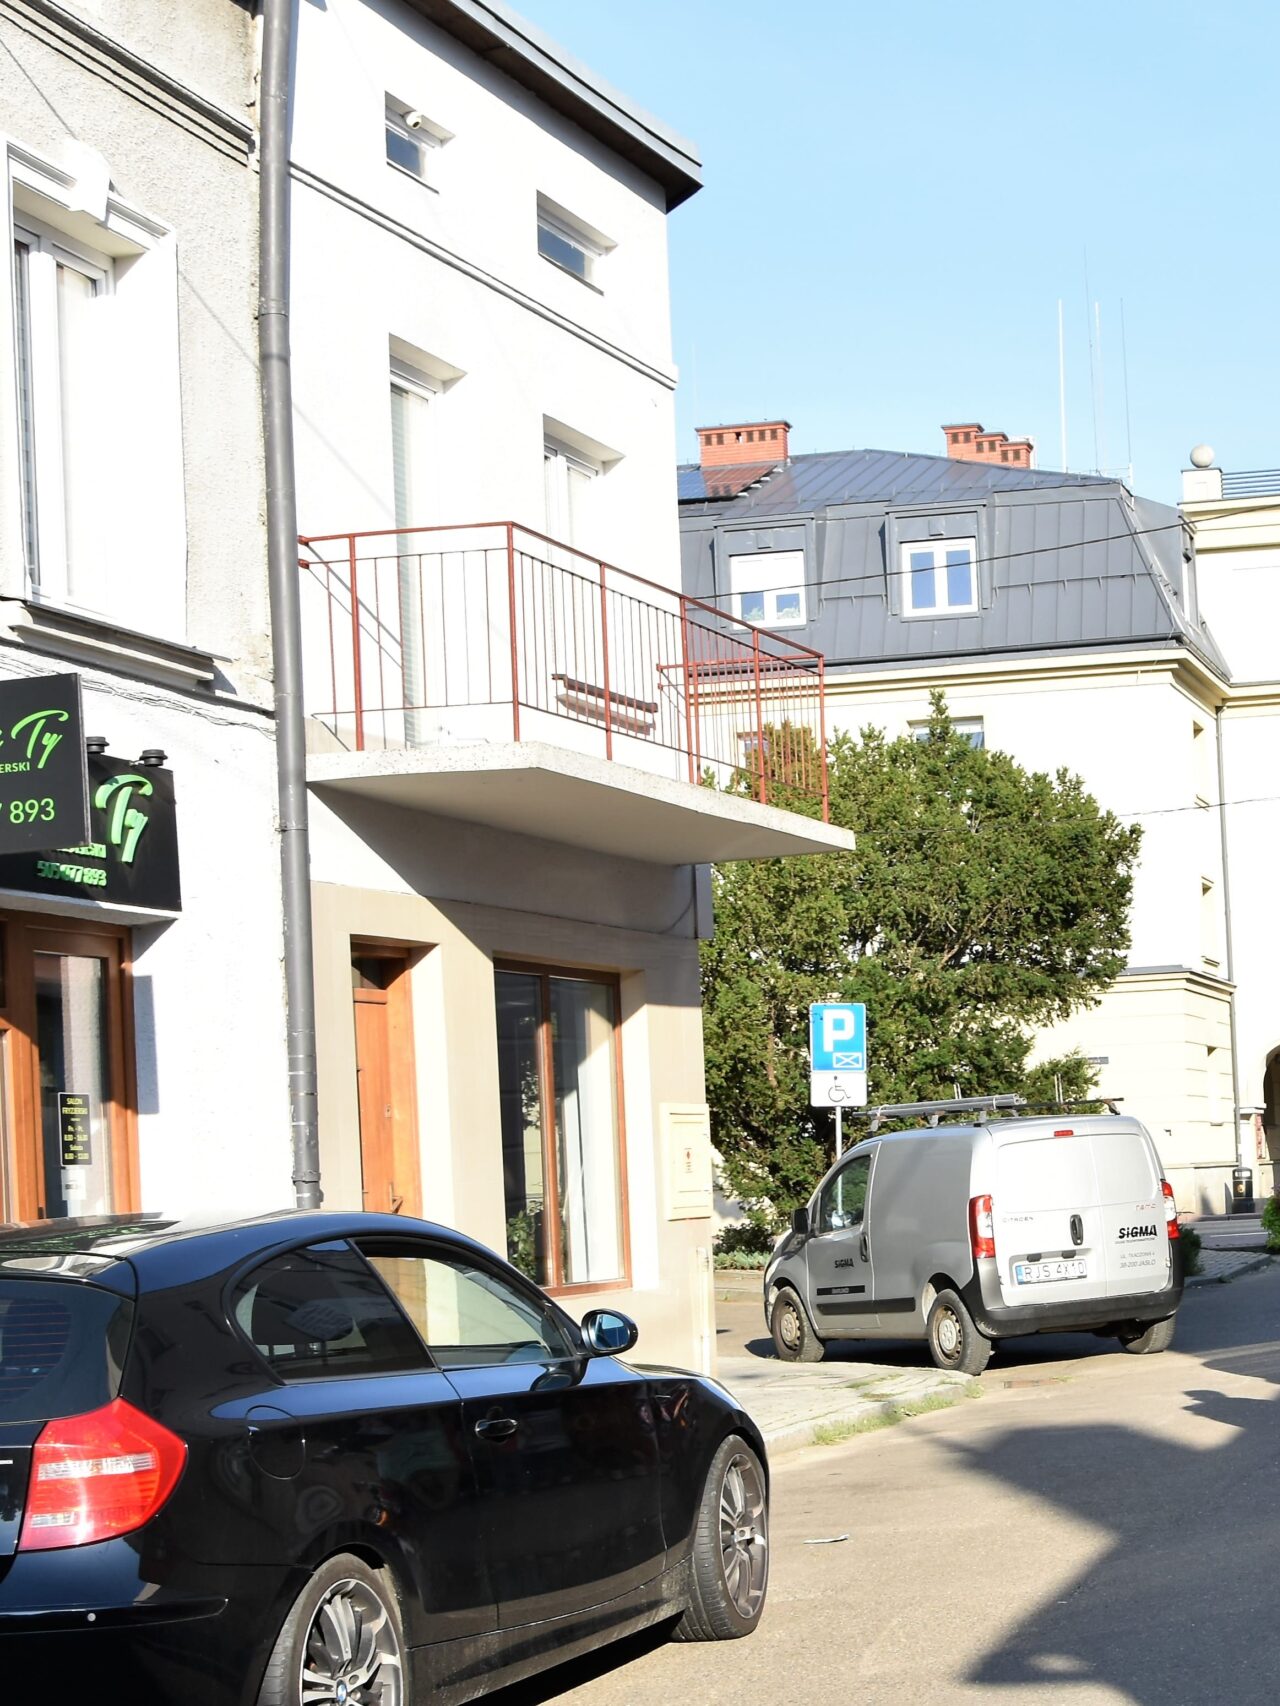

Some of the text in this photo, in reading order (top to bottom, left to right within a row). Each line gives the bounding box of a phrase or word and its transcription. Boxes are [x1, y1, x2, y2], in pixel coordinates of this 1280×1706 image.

[11, 709, 69, 769] Ty
[9, 798, 56, 824] 893
[823, 1009, 855, 1053] P
